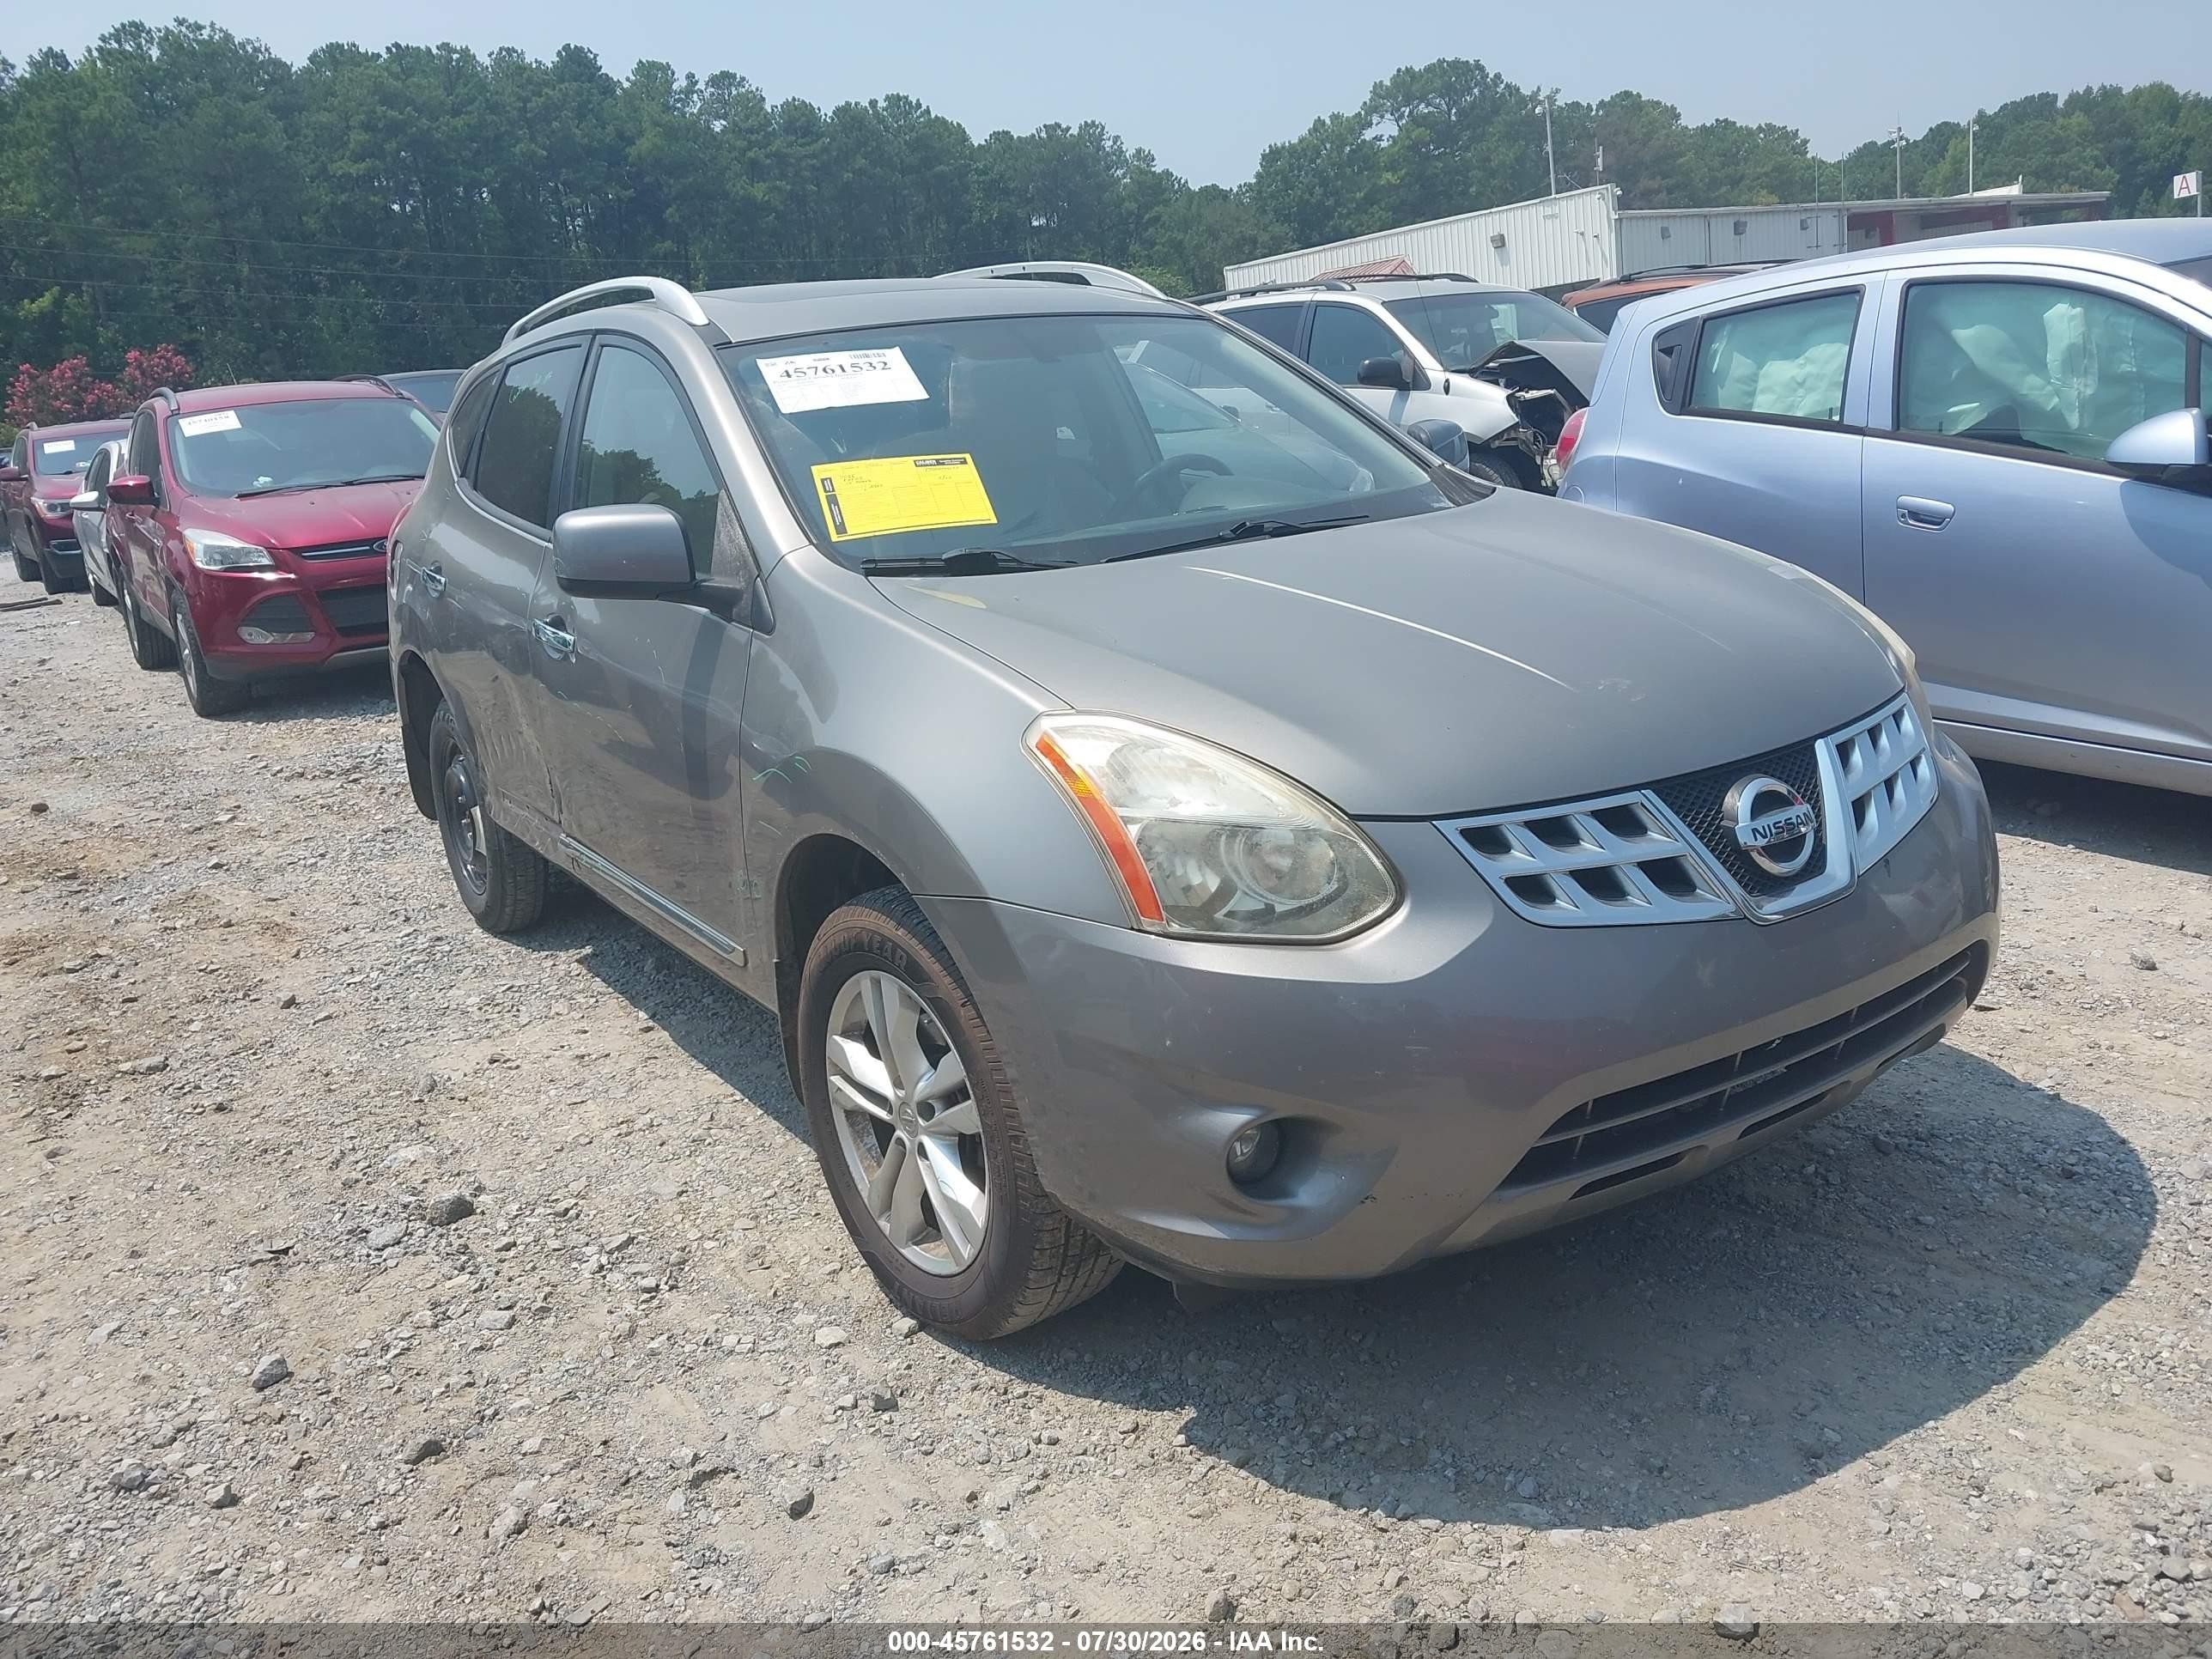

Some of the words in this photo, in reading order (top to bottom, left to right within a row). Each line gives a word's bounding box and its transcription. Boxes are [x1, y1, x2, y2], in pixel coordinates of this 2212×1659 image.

[2177, 174, 2191, 197] A
[779, 360, 892, 379] 45761532
[1751, 810, 1814, 842] NISSAN
